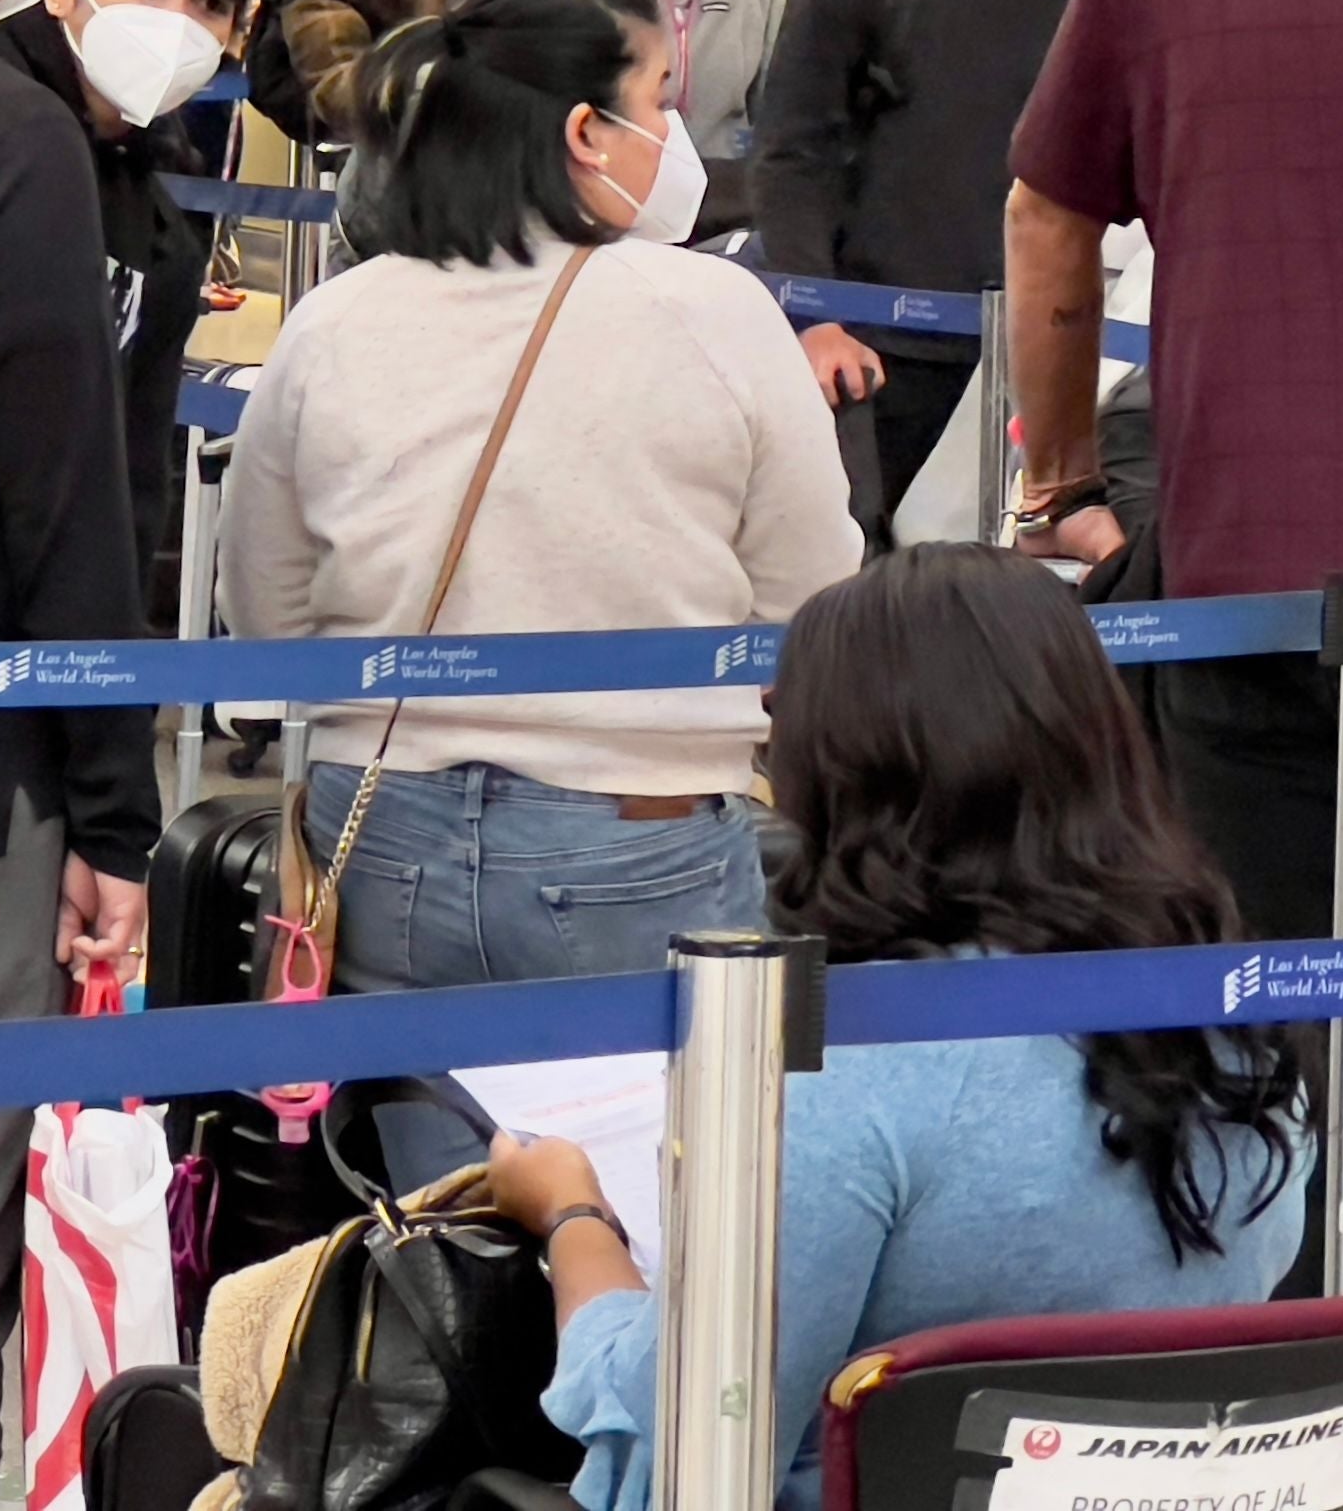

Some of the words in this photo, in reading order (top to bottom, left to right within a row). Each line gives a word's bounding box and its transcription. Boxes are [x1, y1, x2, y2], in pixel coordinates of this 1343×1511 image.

[1099, 631, 1127, 647] orld
[37, 650, 60, 665] Los
[64, 649, 116, 668] Angeles
[36, 668, 78, 684] World
[79, 668, 136, 687] Airports
[1267, 956, 1293, 974] Los
[1267, 978, 1312, 998] World
[1076, 1436, 1210, 1460] JAPAN
[1071, 1491, 1225, 1511] PROPERTY
[1236, 1489, 1270, 1511] OF
[1272, 1482, 1309, 1508] JAL
